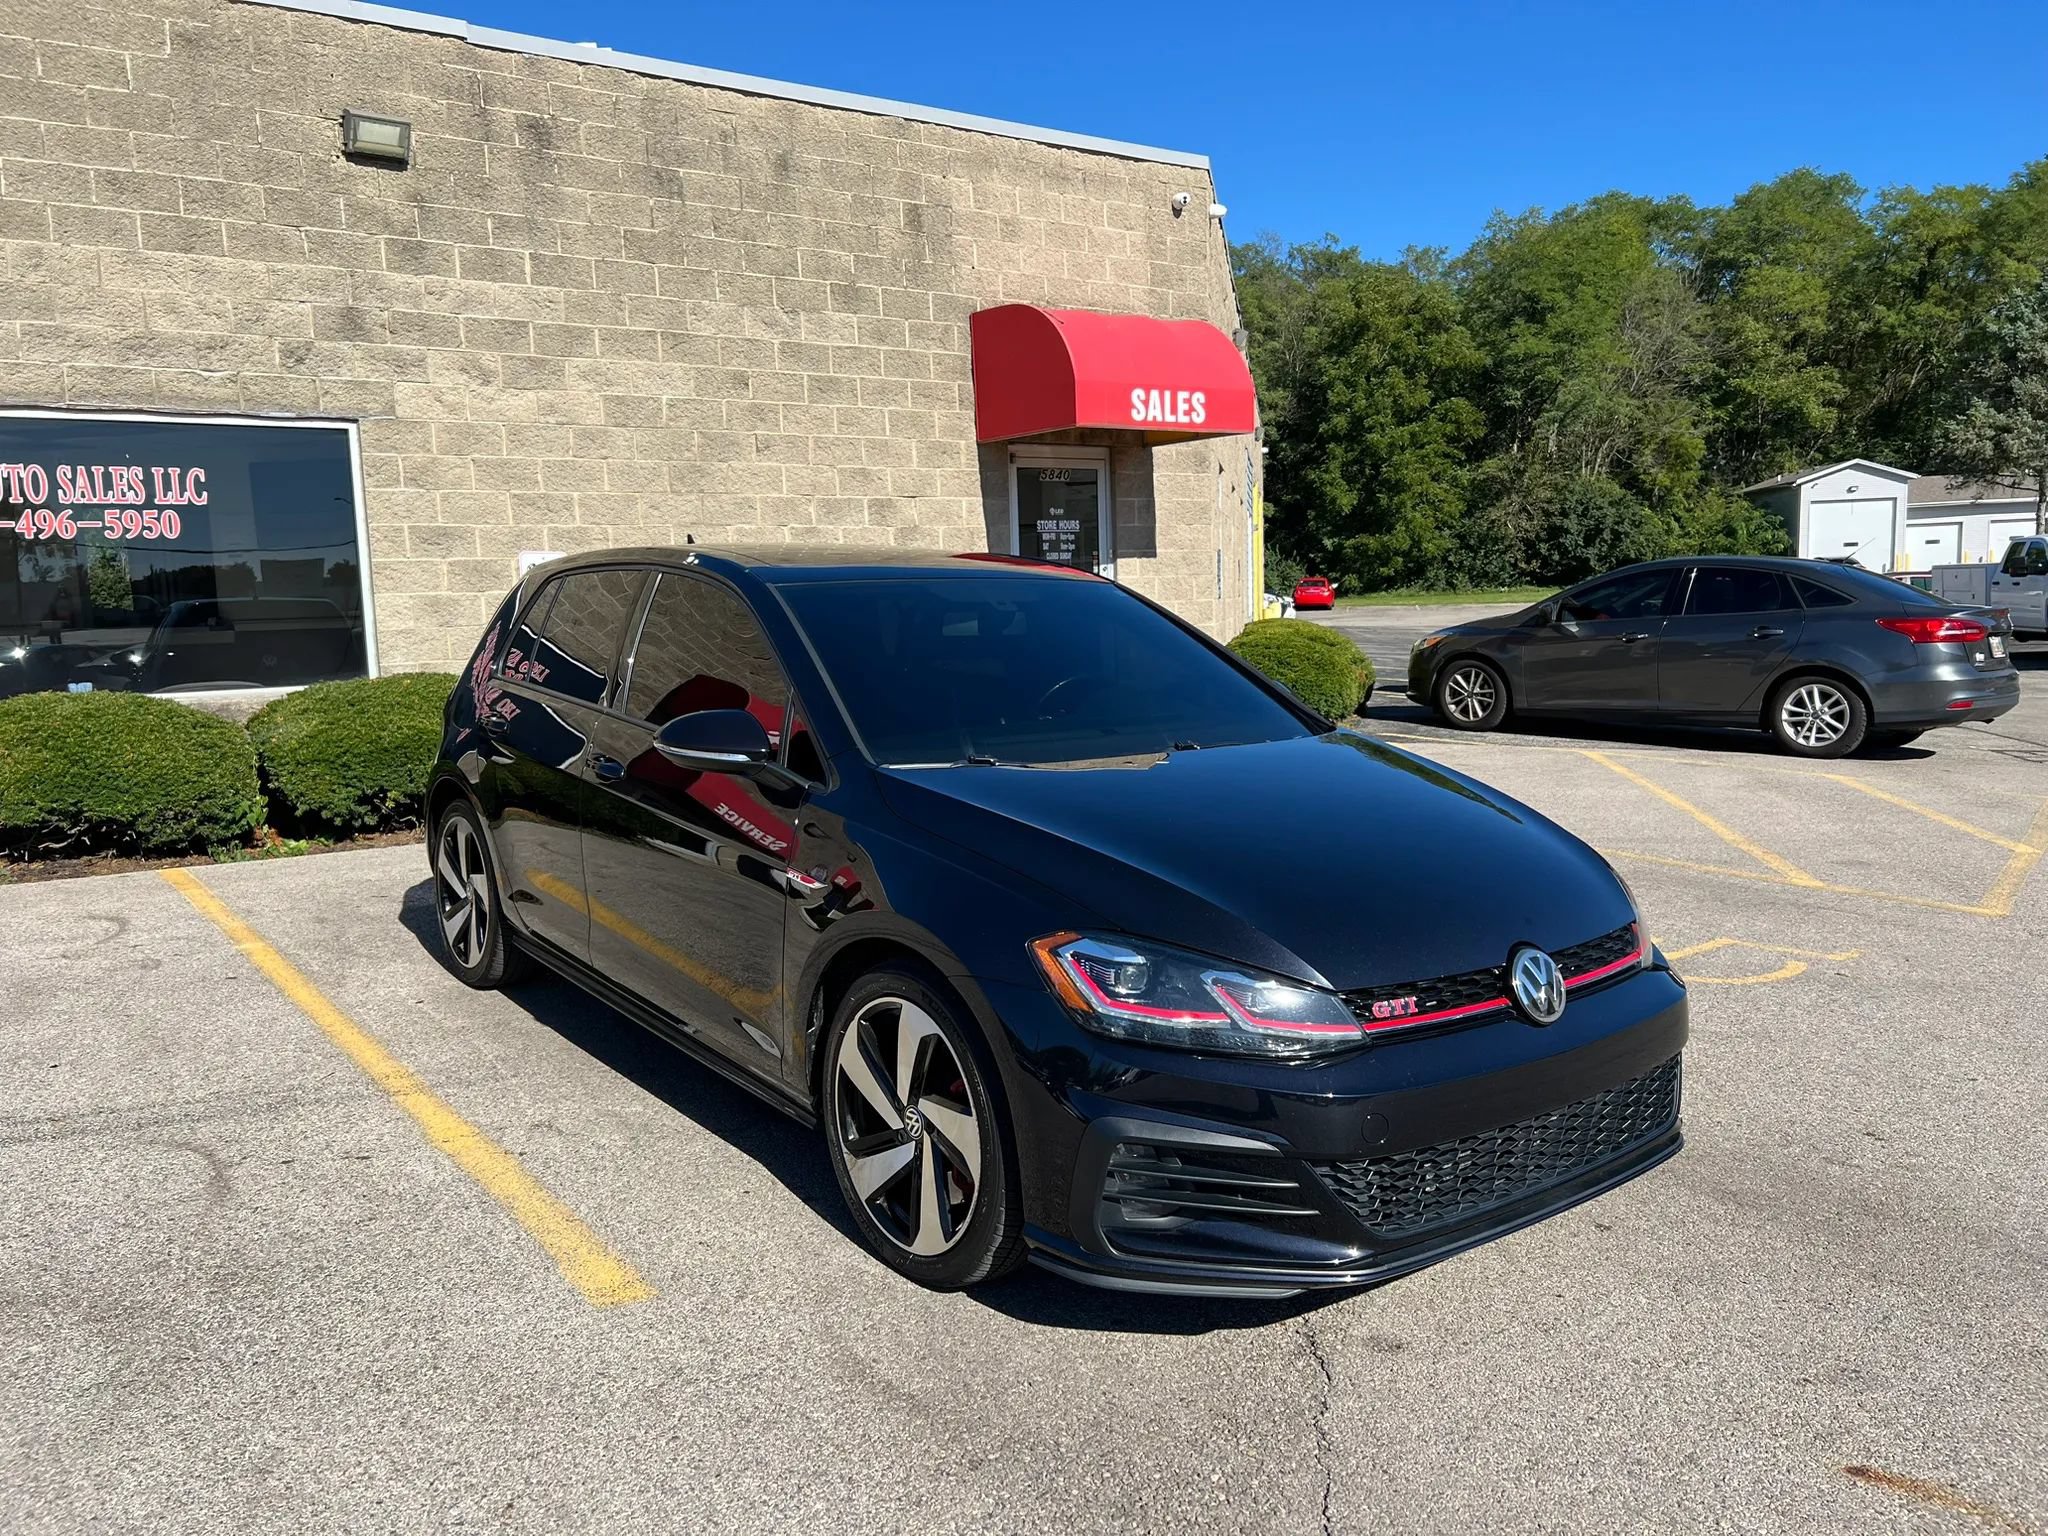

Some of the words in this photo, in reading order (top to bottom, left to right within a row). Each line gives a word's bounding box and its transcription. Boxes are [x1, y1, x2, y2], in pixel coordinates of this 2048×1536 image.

[1131, 387, 1206, 424] SALES
[0, 463, 49, 504] TO
[56, 465, 145, 504] SALES
[152, 467, 208, 505] LLC
[1040, 469, 1070, 481] 5840
[1036, 520, 1057, 530] STORE
[1059, 520, 1080, 530] HOURS
[1372, 996, 1419, 1018] GTI
